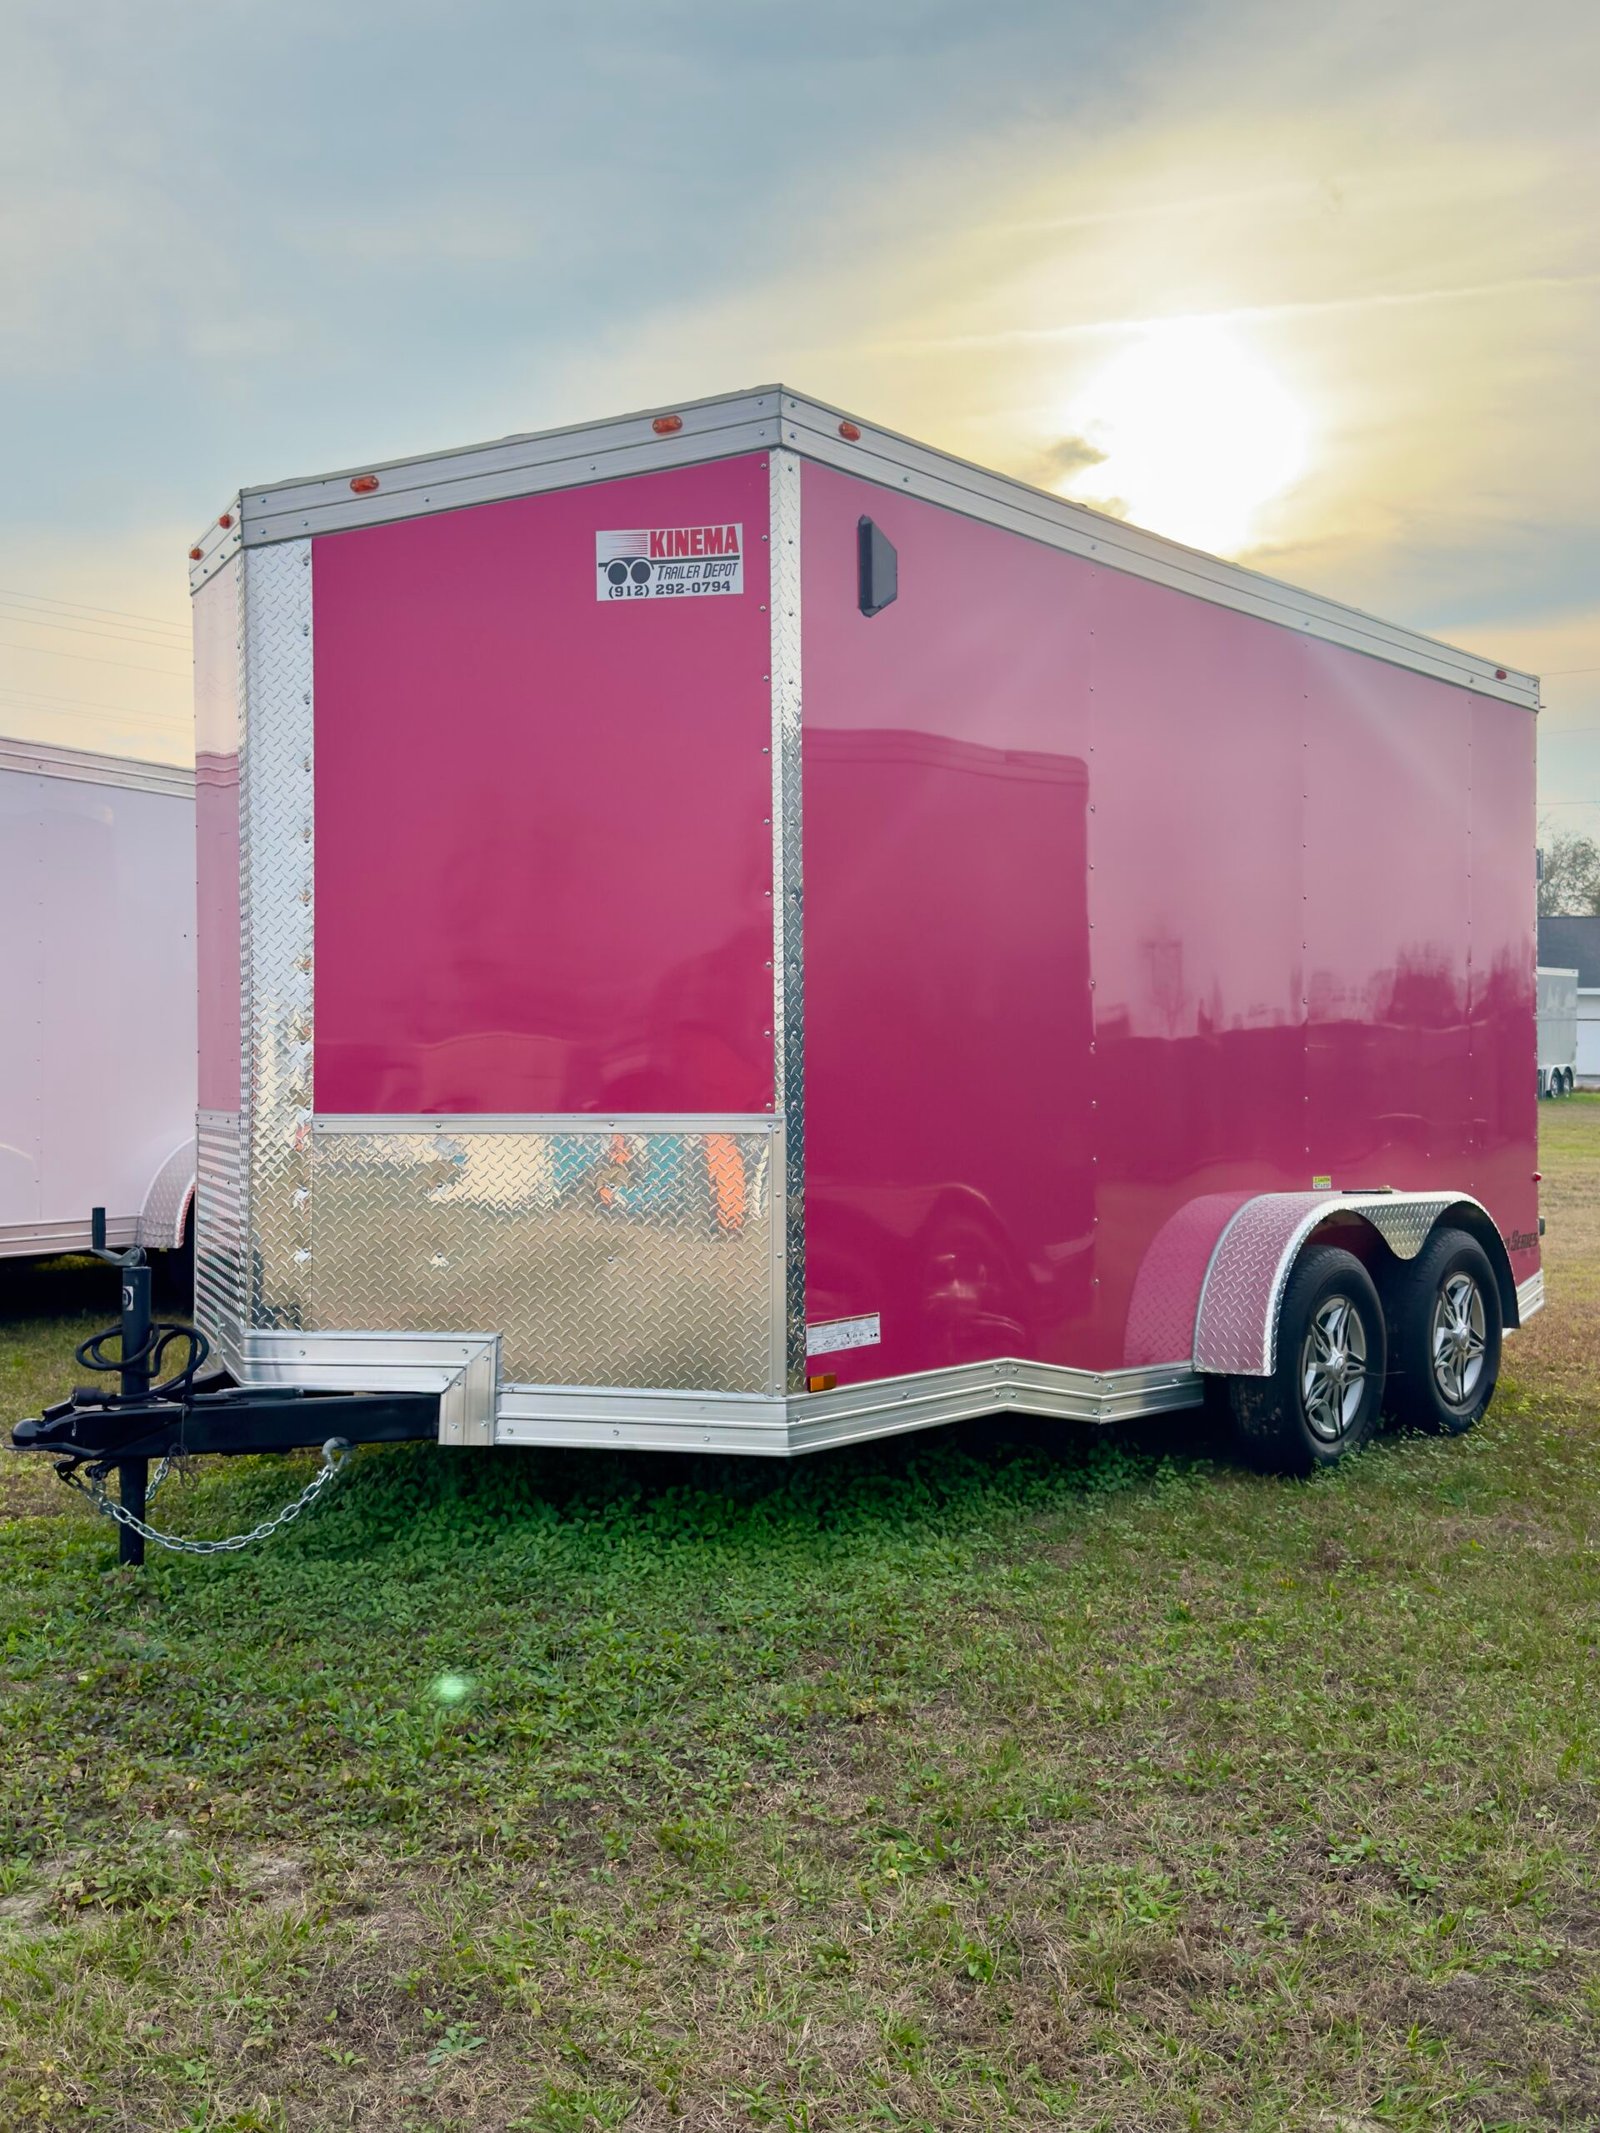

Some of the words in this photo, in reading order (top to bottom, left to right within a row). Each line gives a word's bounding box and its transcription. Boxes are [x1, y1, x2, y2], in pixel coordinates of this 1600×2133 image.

[650, 526, 739, 558] KINEMA
[658, 564, 700, 581] TRAILER
[703, 562, 739, 578] DEPOT
[608, 585, 649, 599] (912)
[656, 581, 730, 595] 292-0794
